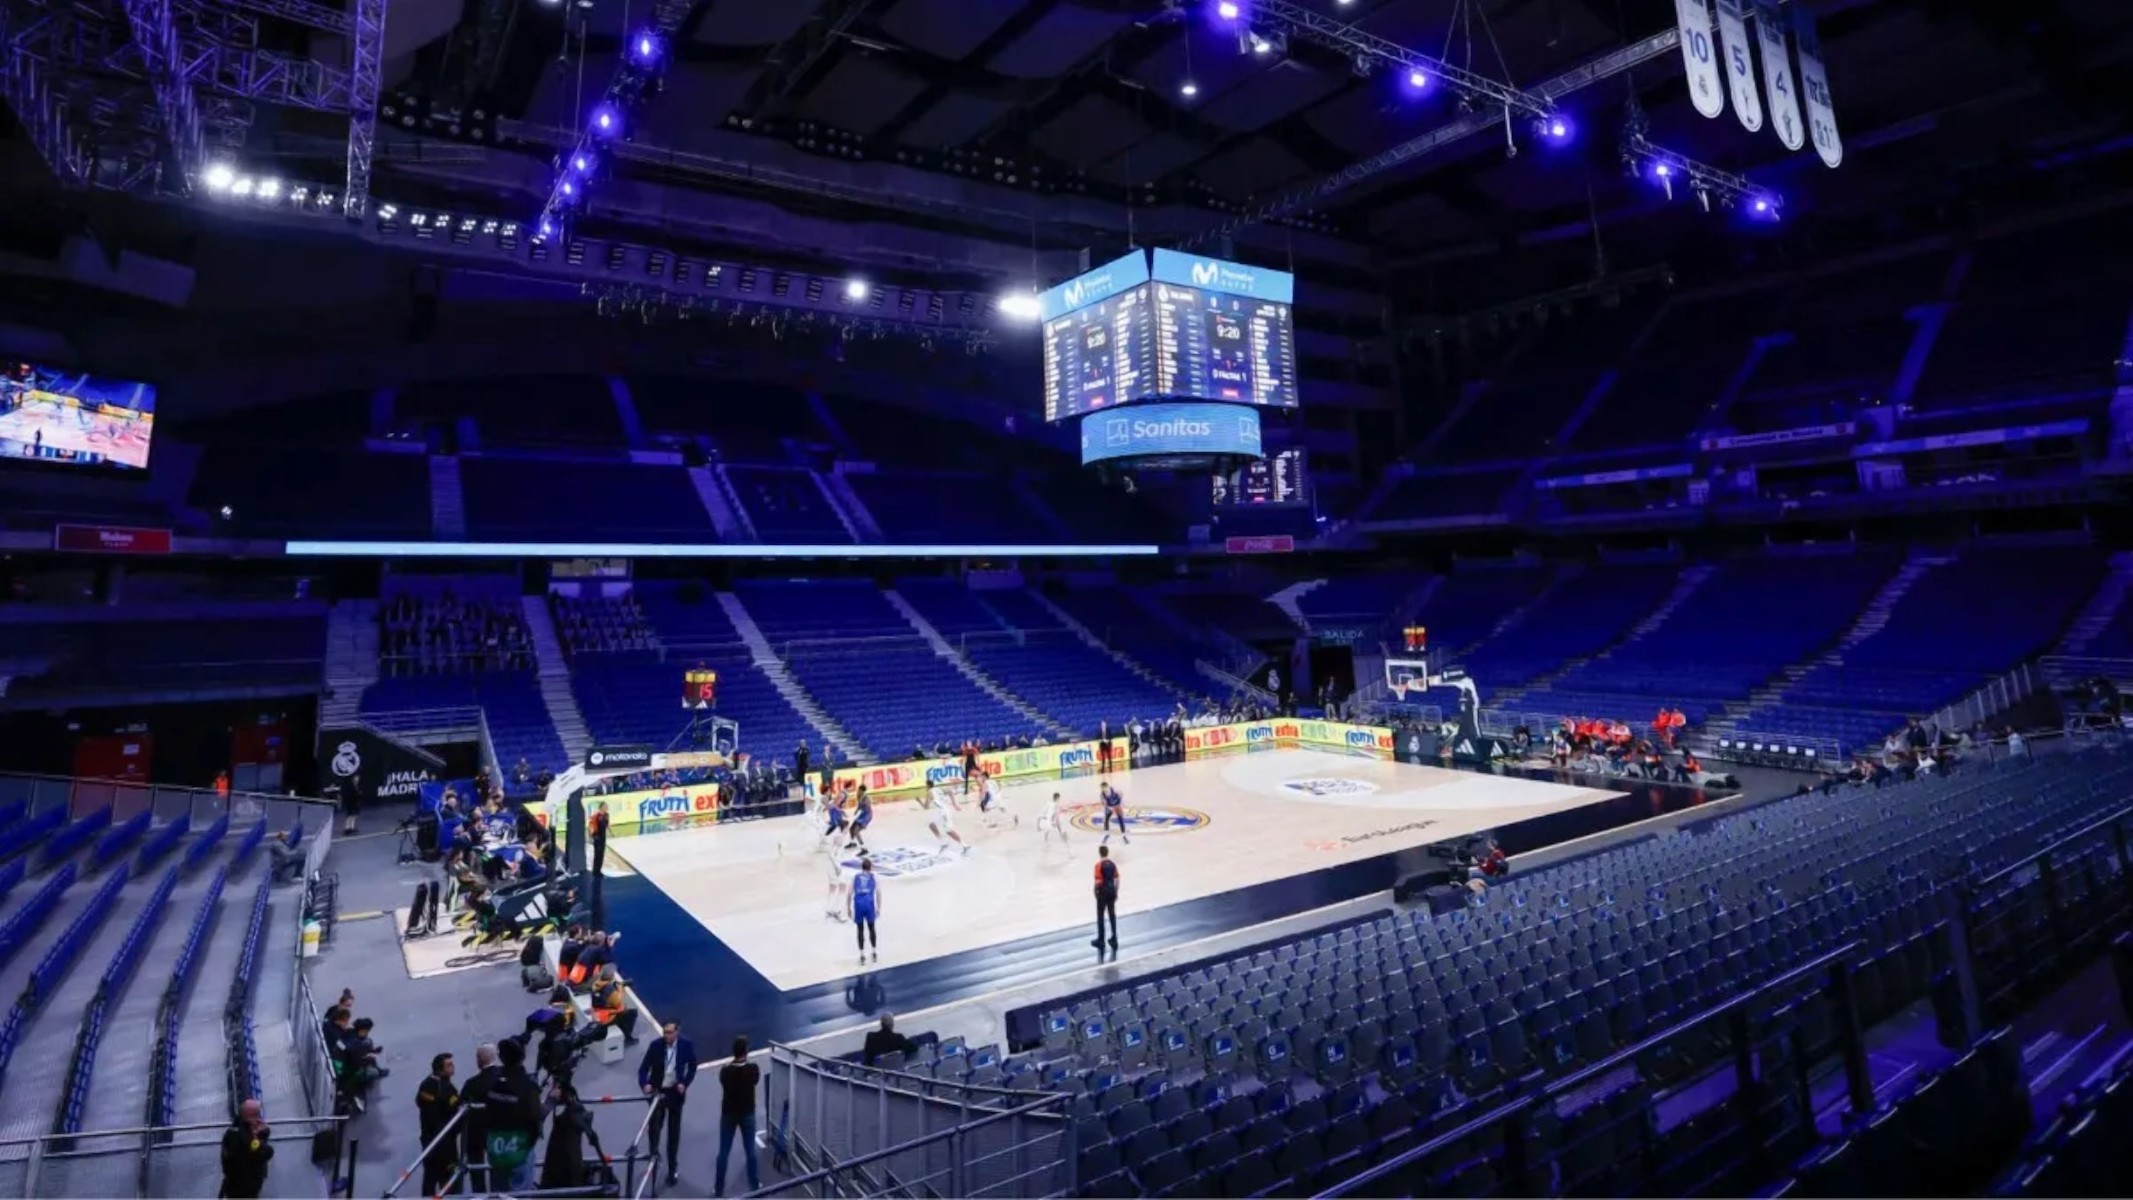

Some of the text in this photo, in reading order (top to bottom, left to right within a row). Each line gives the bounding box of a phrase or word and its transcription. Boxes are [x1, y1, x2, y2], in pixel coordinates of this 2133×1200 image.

[1685, 27, 1709, 63] 10
[1732, 44, 1746, 77] 5
[1216, 324, 1240, 340] 9:20
[1133, 418, 1211, 438] Sanitas
[700, 683, 713, 699] 15
[604, 752, 648, 762] motorola
[377, 781, 419, 797] MADR
[638, 789, 690, 818] FRUTTI
[493, 1136, 519, 1154] 04
